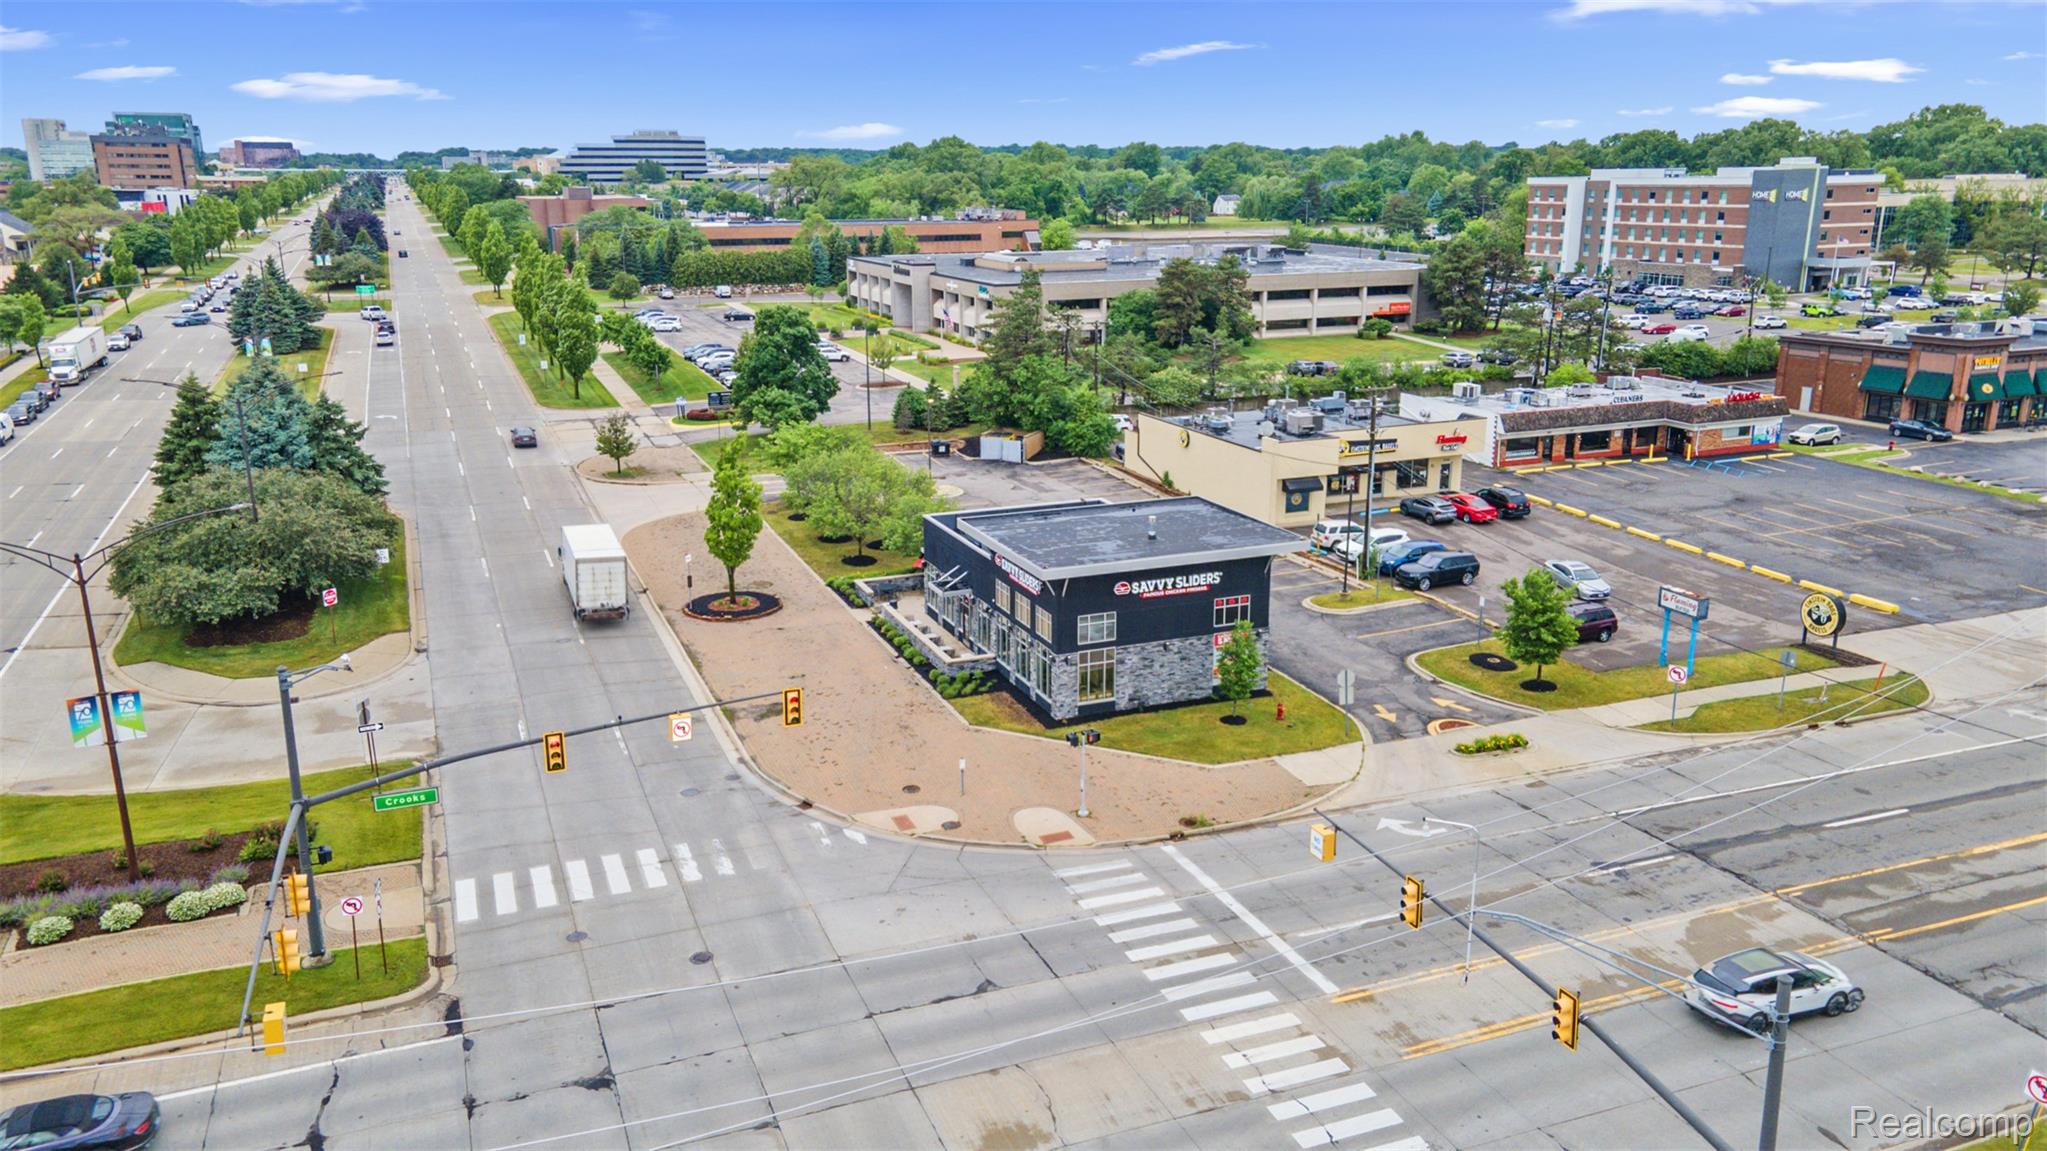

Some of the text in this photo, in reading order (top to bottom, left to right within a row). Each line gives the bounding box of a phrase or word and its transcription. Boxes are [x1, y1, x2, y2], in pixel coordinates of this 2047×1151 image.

[1752, 190, 1769, 200] HOME
[1785, 190, 1803, 200] HOME
[1613, 394, 1644, 404] CLEANERS
[1728, 391, 1761, 403] LIQUOR
[1132, 572, 1221, 594] SAVVY SLIDERS
[1671, 594, 1697, 611] Flaming
[385, 794, 426, 806] Crooks
